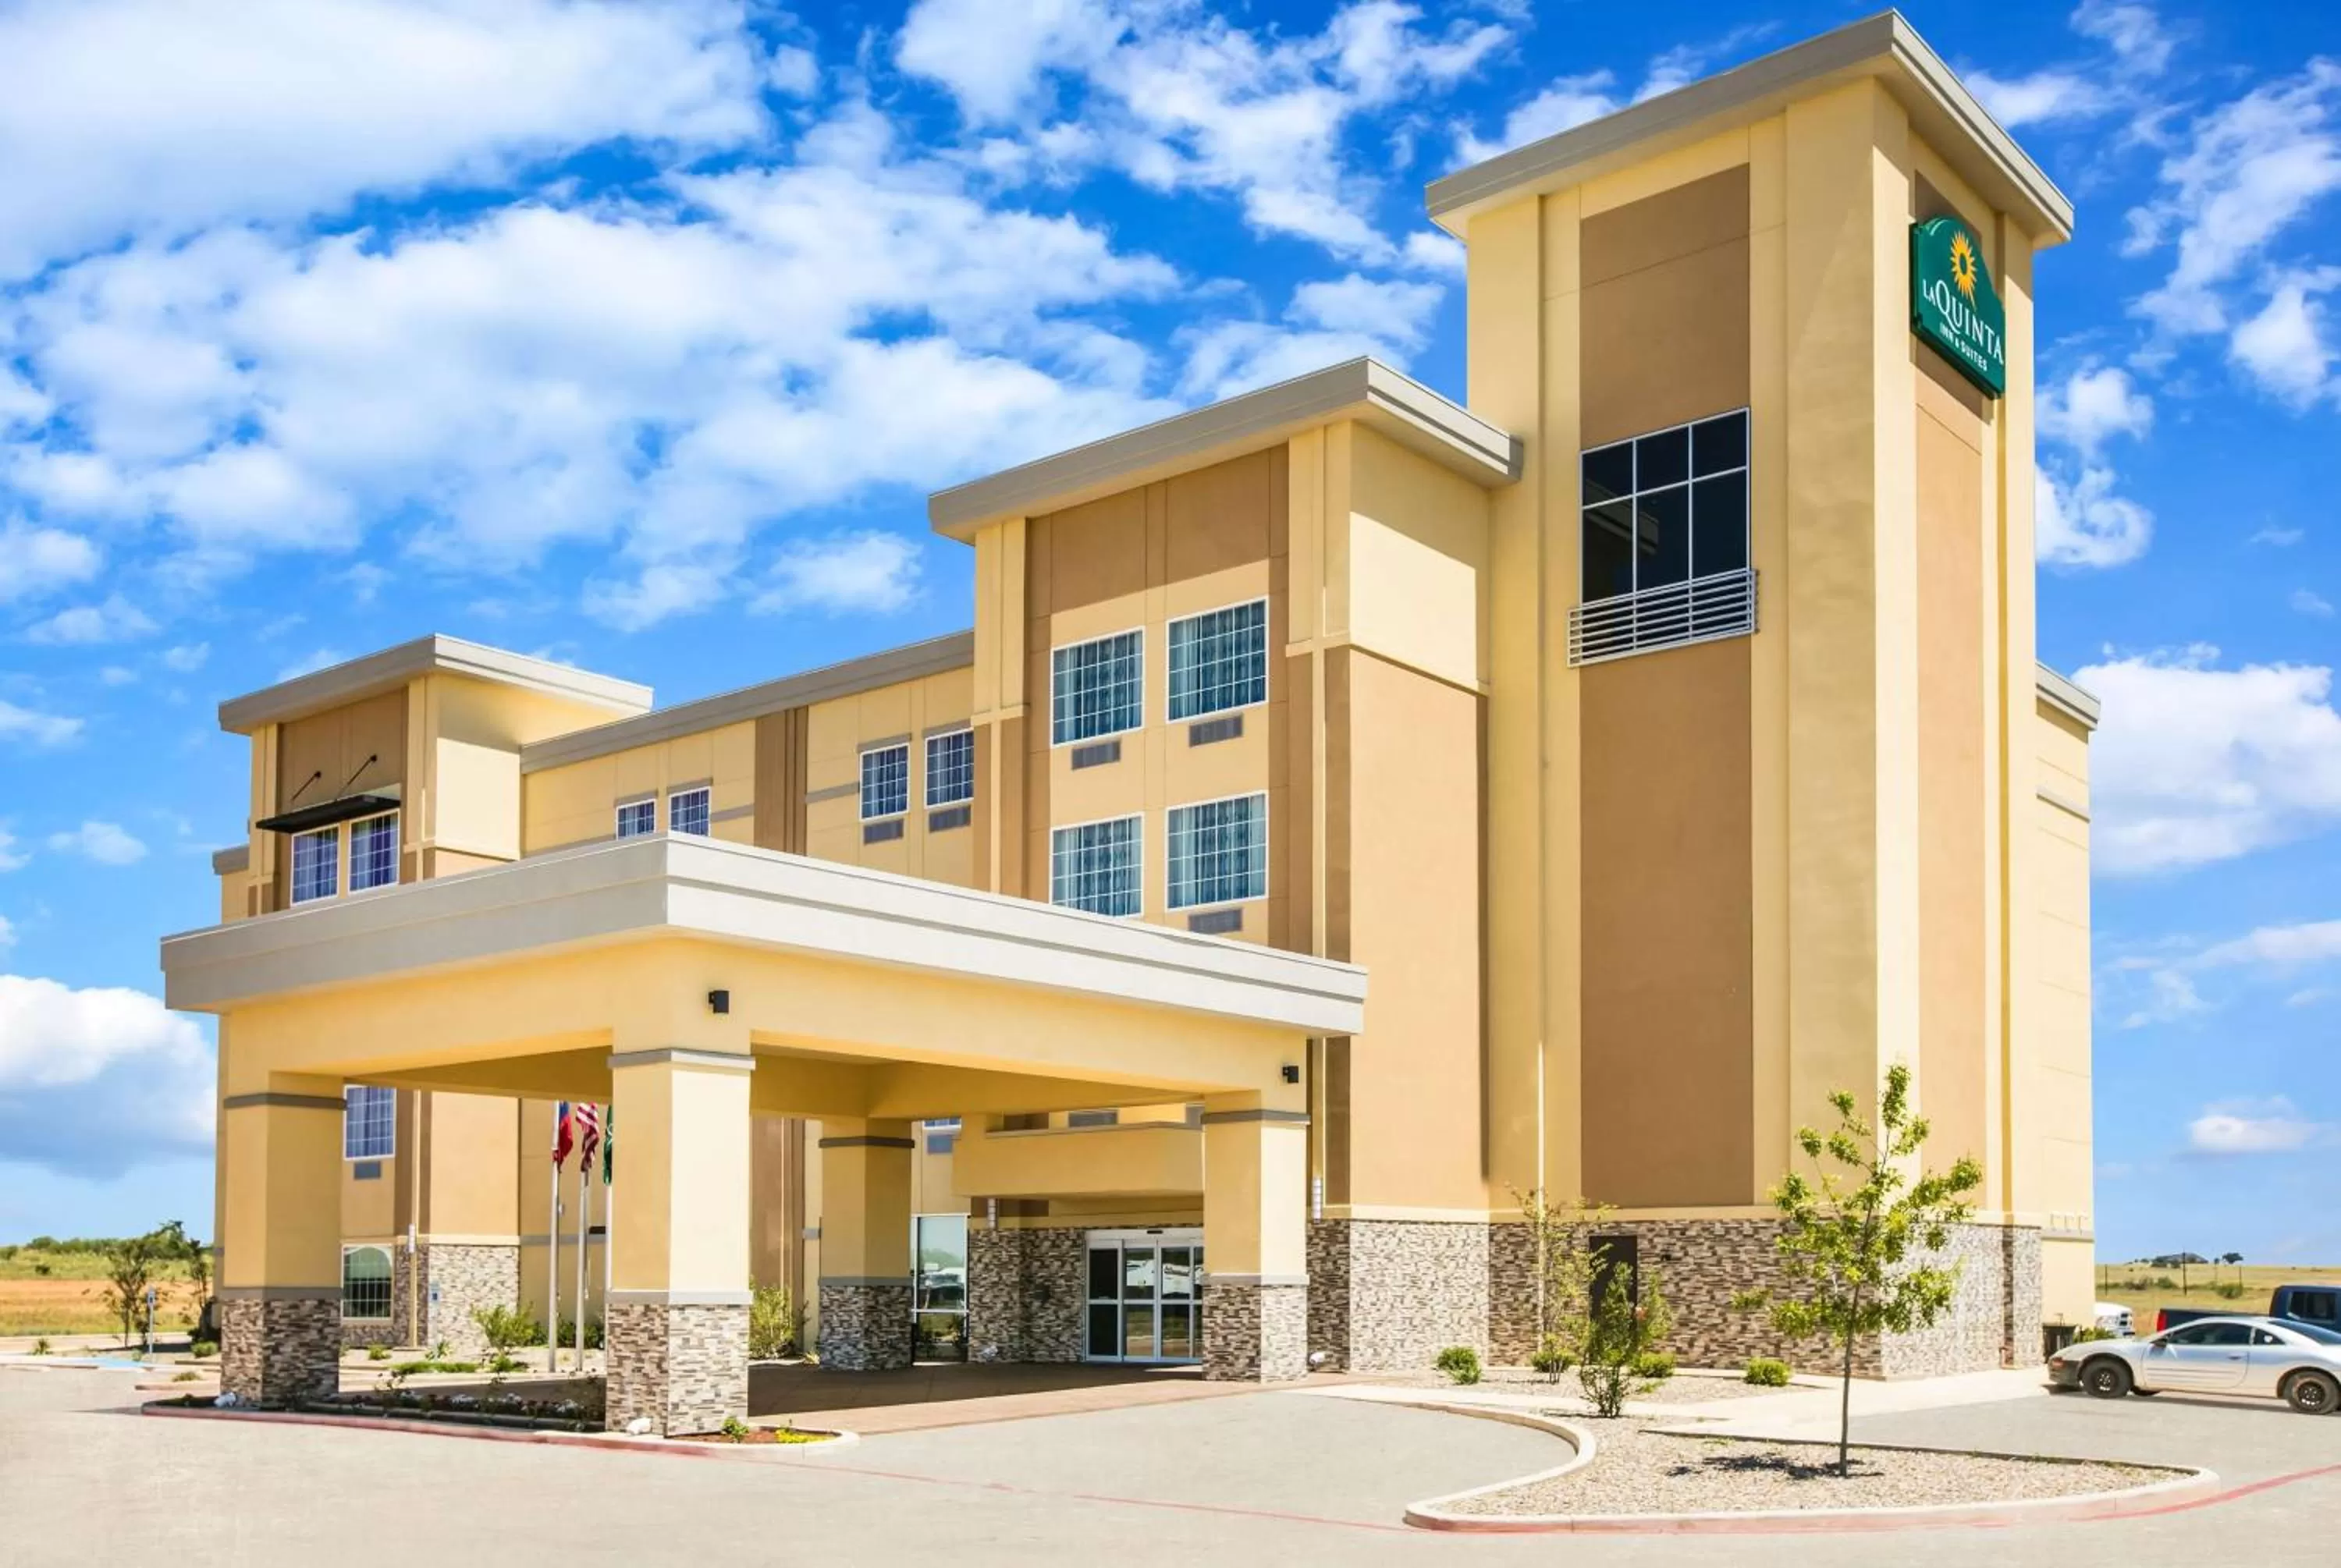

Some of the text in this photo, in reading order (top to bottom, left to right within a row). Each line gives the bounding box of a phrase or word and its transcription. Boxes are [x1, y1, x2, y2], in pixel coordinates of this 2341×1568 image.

[1922, 279, 2004, 365] LA QUINTA
[1939, 321, 1988, 372] INN & SUITES
